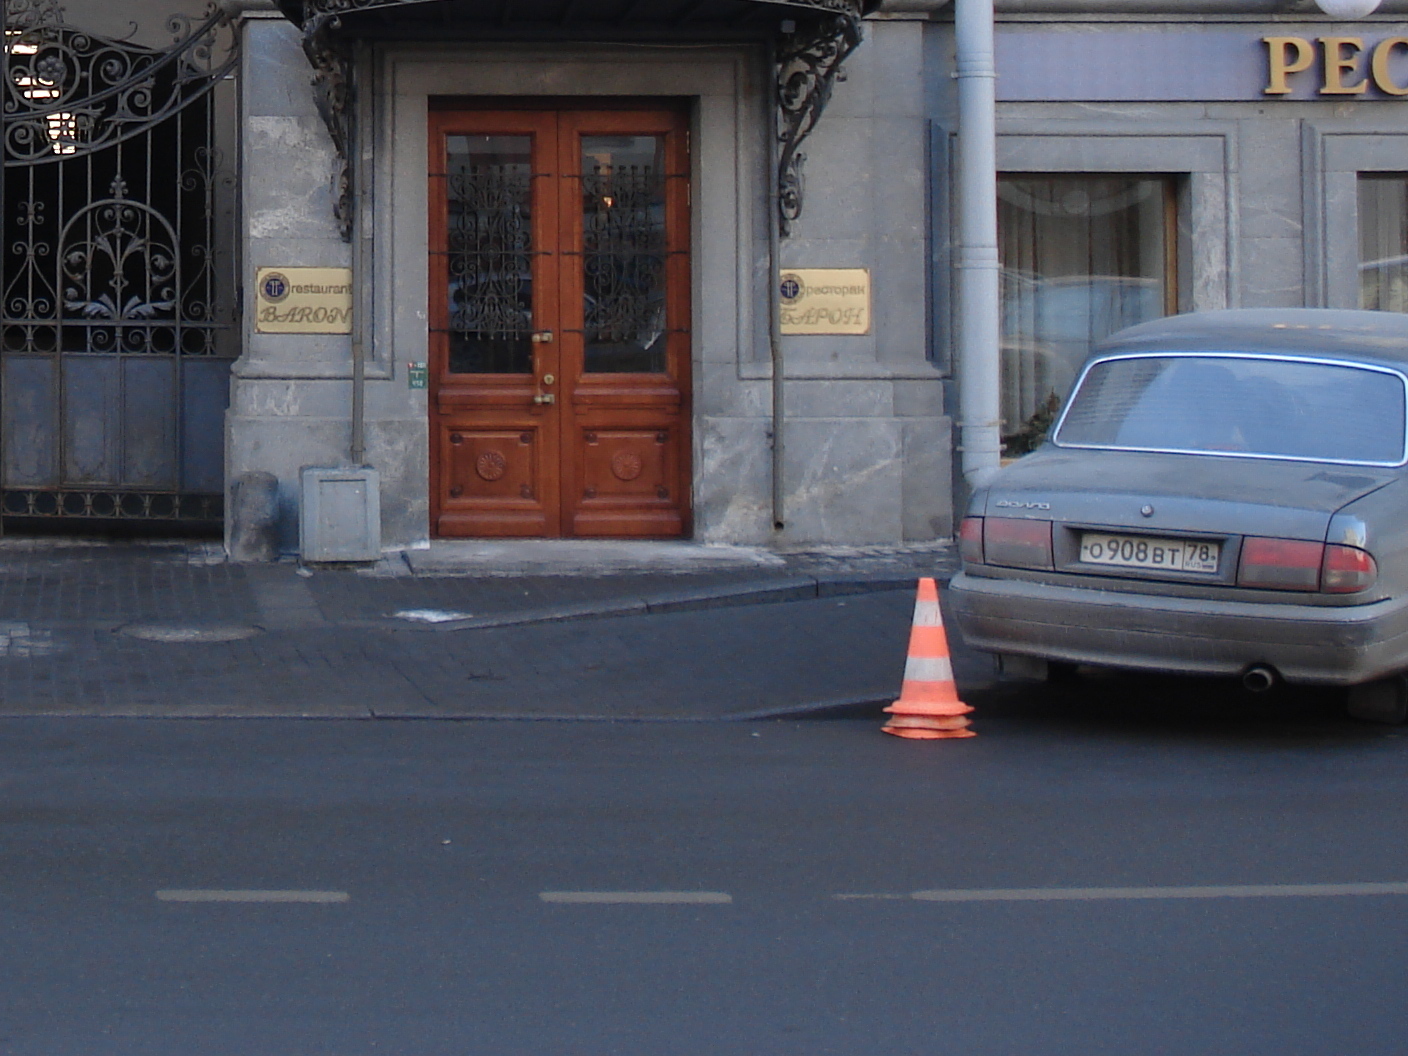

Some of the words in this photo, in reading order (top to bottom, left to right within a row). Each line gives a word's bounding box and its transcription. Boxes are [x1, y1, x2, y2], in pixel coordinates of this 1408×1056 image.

[258, 306, 352, 324] BARON
[1089, 538, 1180, 566] О908ВТ
[1187, 544, 1210, 562] 78
